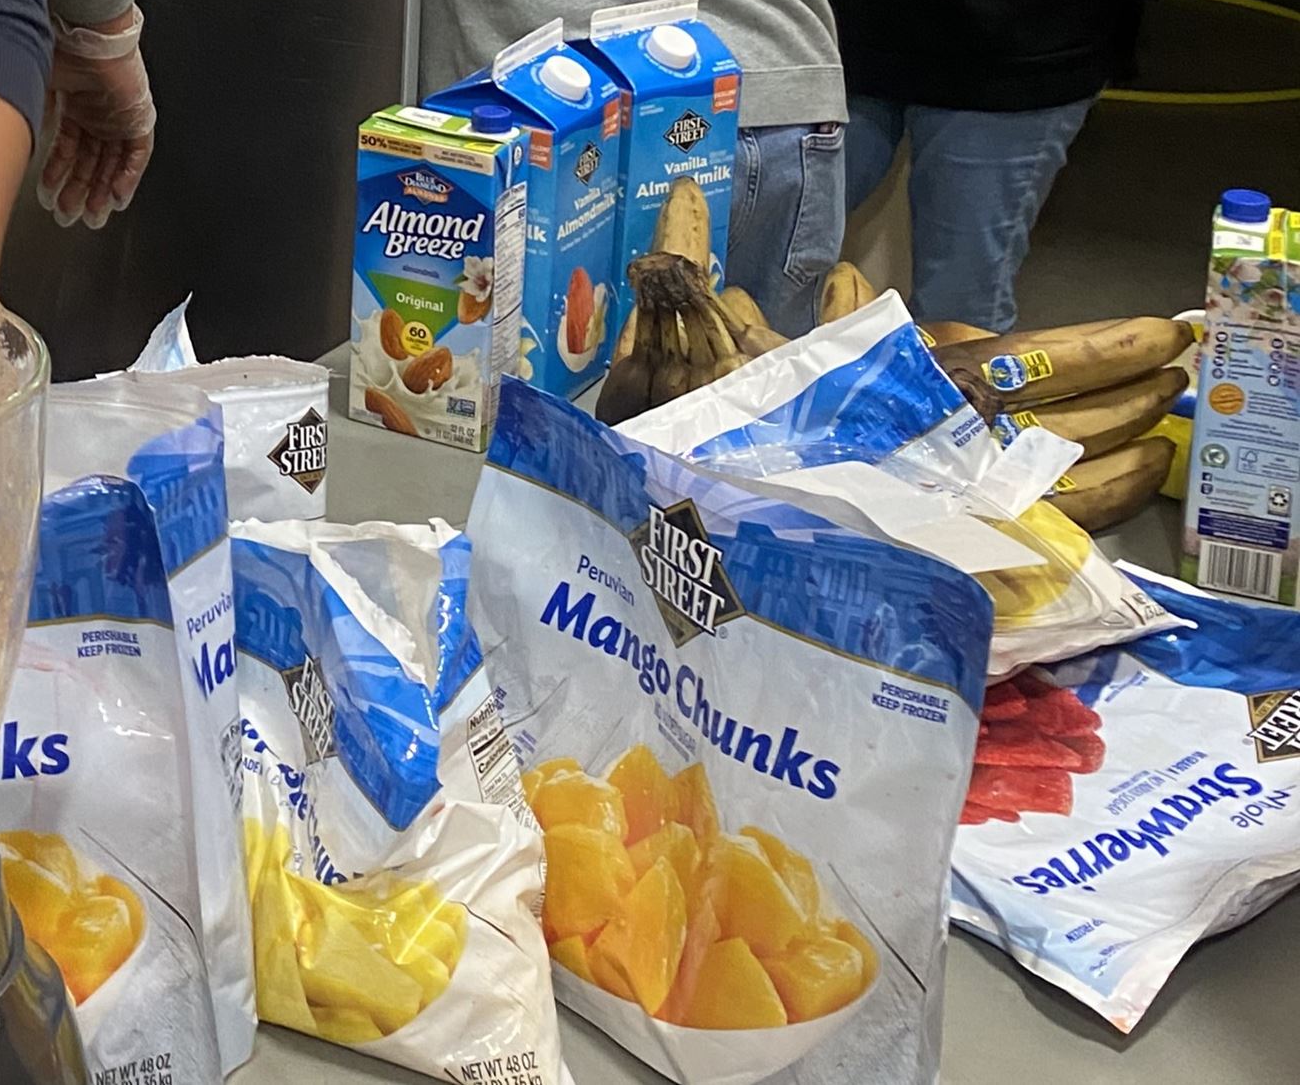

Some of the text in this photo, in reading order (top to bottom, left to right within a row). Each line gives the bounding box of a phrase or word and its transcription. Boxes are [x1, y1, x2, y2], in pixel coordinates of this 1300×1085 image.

[668, 126, 706, 147] STREET
[674, 116, 703, 133] FIRST
[361, 134, 387, 149] 50%
[664, 156, 708, 175] Vanilla
[636, 165, 732, 199] Almmilk
[363, 201, 485, 242] Almond
[557, 192, 616, 240] Almondmilk
[385, 233, 464, 259] Breeze
[396, 292, 444, 312] Original
[409, 326, 426, 339] 60
[280, 447, 326, 474] STRE
[649, 504, 722, 588] FIRST
[576, 554, 636, 607] Peruvian
[640, 545, 725, 636] STREET
[186, 592, 233, 641] Peruvia
[77, 643, 142, 658] KEEP FROZEN
[82, 630, 139, 644] PERISHABLE
[539, 582, 672, 697] Mango
[675, 664, 842, 799] Chunks
[881, 681, 950, 711] PERISHABLE
[872, 693, 948, 724] KEEP FROZEN
[1014, 762, 1262, 895] Strawberries
[95, 1052, 172, 1085] NET WT 48 OZ
[461, 1051, 538, 1082] NET WT 48 OZ
